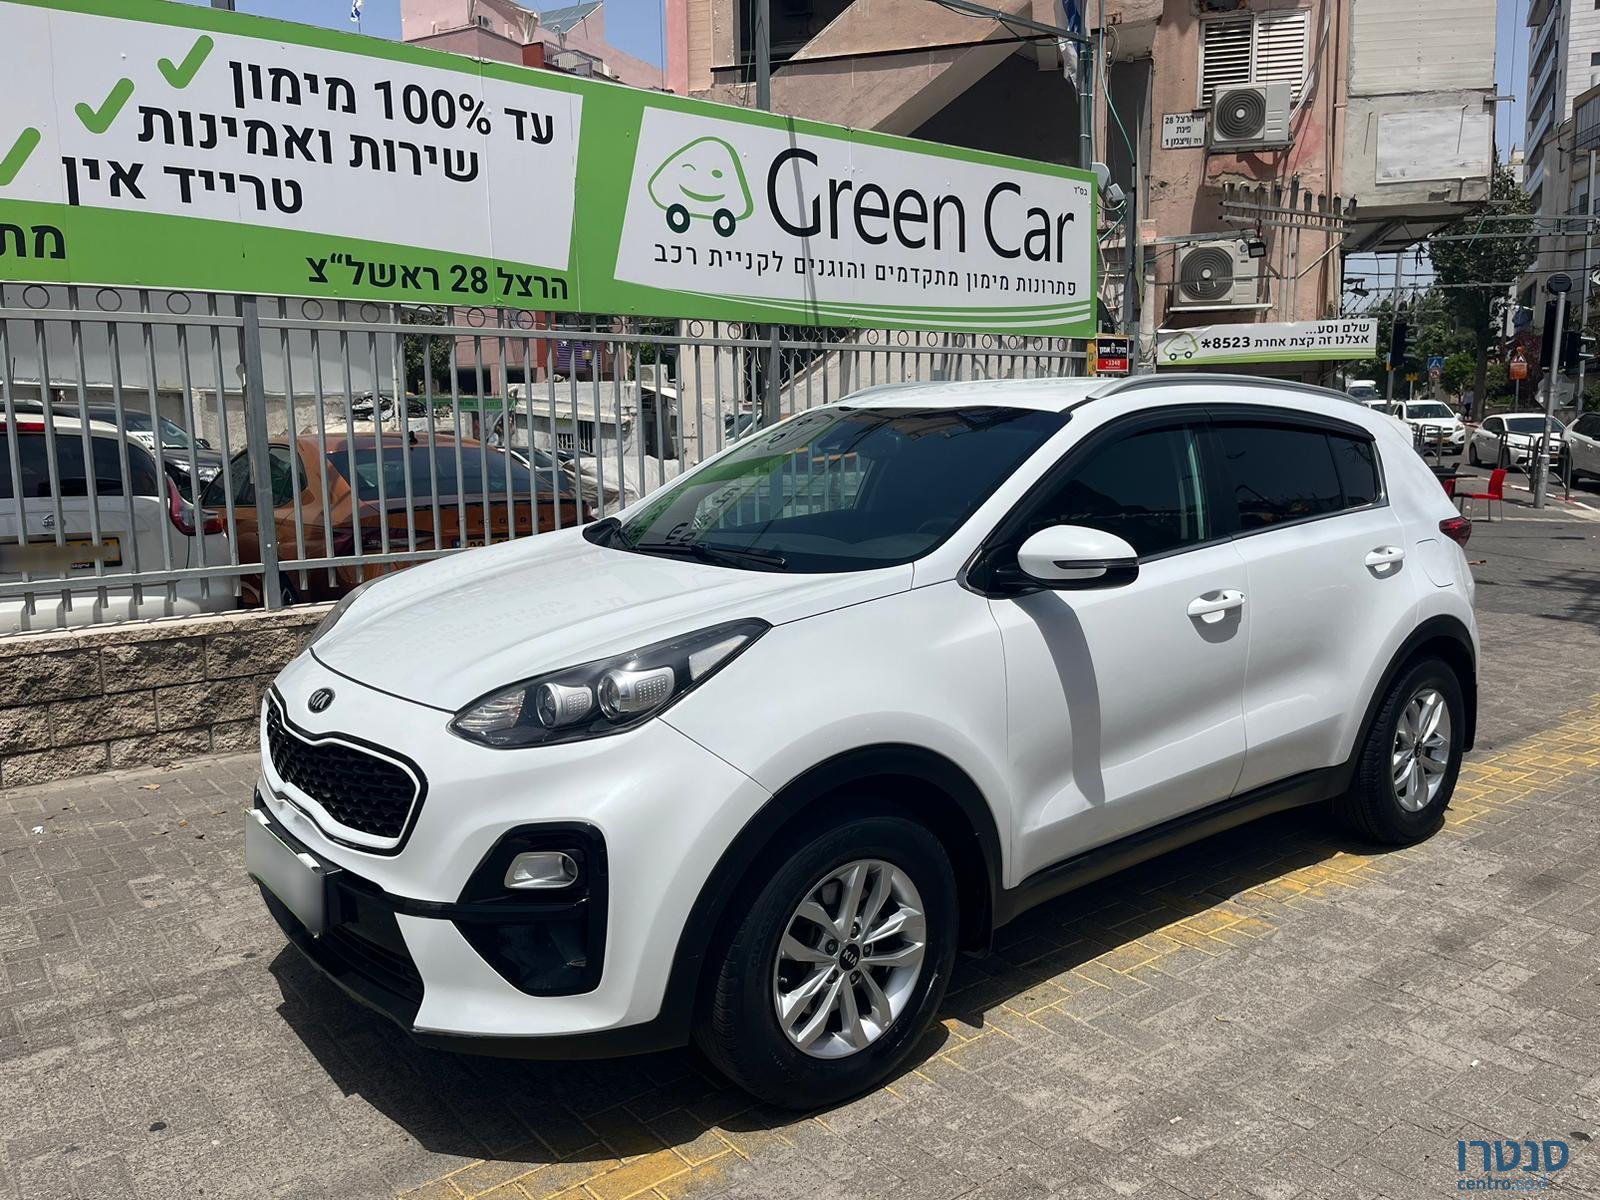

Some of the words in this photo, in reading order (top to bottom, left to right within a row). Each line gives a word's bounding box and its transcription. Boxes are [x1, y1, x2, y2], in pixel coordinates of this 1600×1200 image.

[228, 60, 357, 114] מימון
[373, 80, 493, 135] 100%
[137, 105, 333, 164] ואמינות
[503, 107, 555, 145] עד
[349, 134, 479, 183] שירות
[62, 156, 146, 207] אין
[163, 165, 303, 214] טרייד
[766, 147, 967, 254] Green
[984, 181, 1076, 265] Car
[653, 243, 698, 265] רכב
[707, 248, 784, 277] לקניית
[449, 264, 488, 294] 28
[496, 266, 569, 300] הרצל
[793, 257, 866, 282] והוגנים
[874, 264, 959, 290] מתקדמים
[966, 271, 1010, 293] מימון
[1015, 277, 1077, 297] פתרונות
[1254, 337, 1286, 347] אחרת
[1289, 336, 1315, 348] קצת
[1318, 336, 1331, 345] זה
[1336, 334, 1369, 345] אצלנו
[1343, 323, 1370, 334] שלם
[843, 949, 858, 966] KIA
